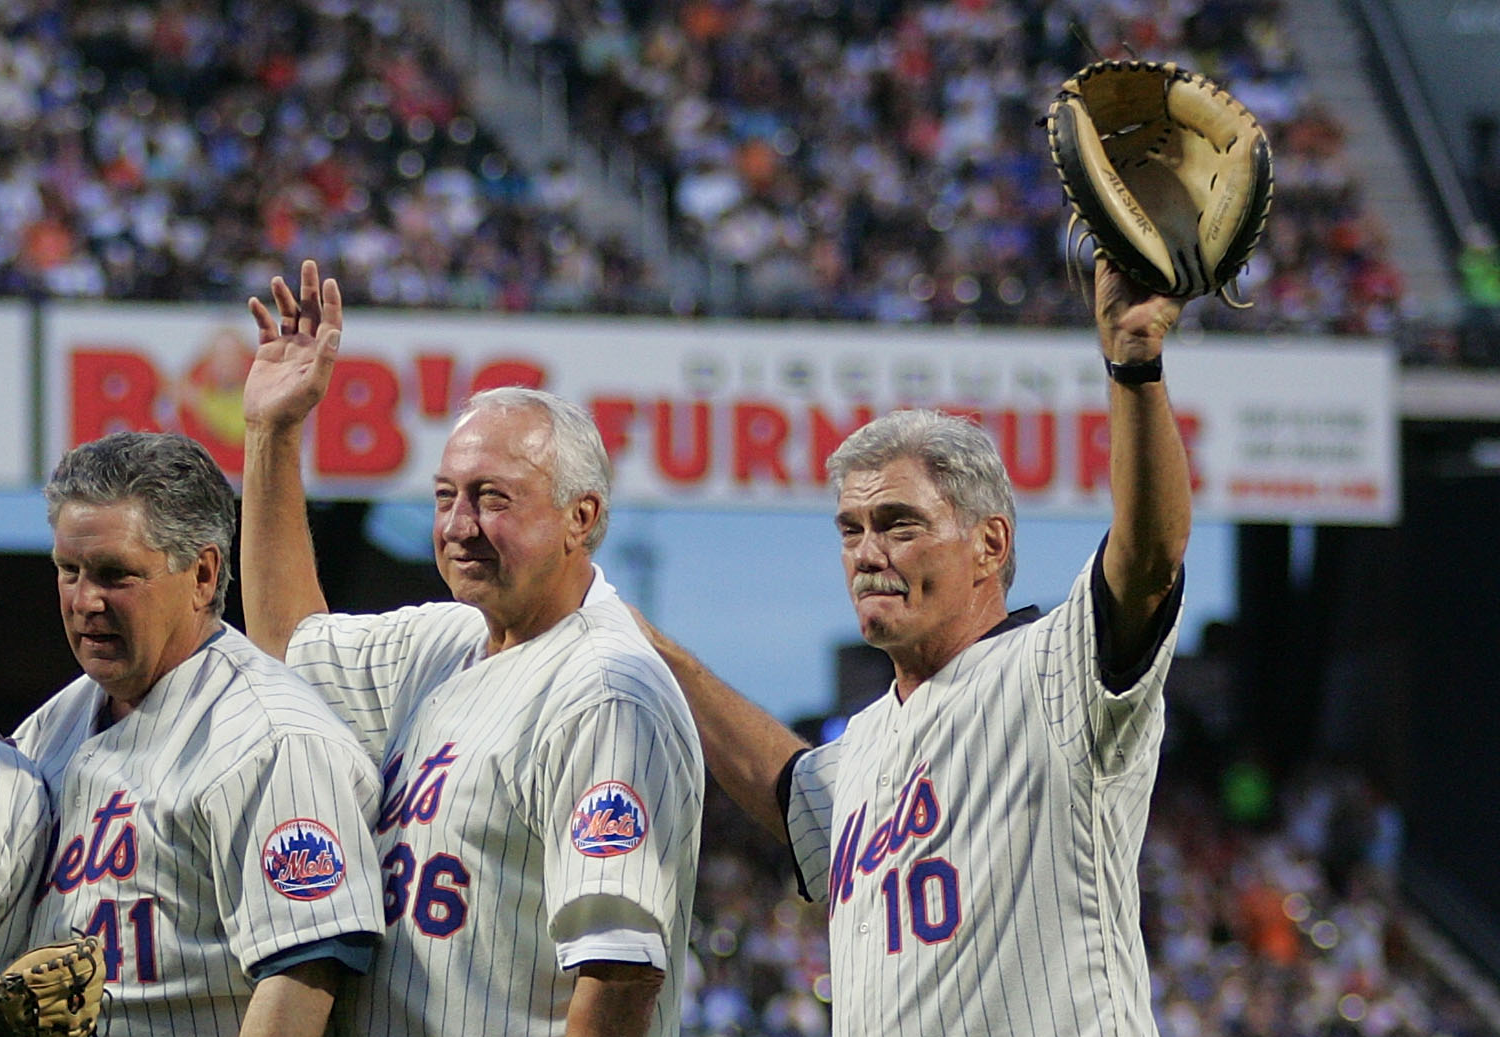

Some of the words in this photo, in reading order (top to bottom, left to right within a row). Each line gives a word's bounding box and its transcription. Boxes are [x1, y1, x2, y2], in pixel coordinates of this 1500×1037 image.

[580, 808, 637, 840] Mets
[279, 848, 335, 881] Mets
[881, 857, 963, 956] 10
[84, 898, 159, 984] 41
